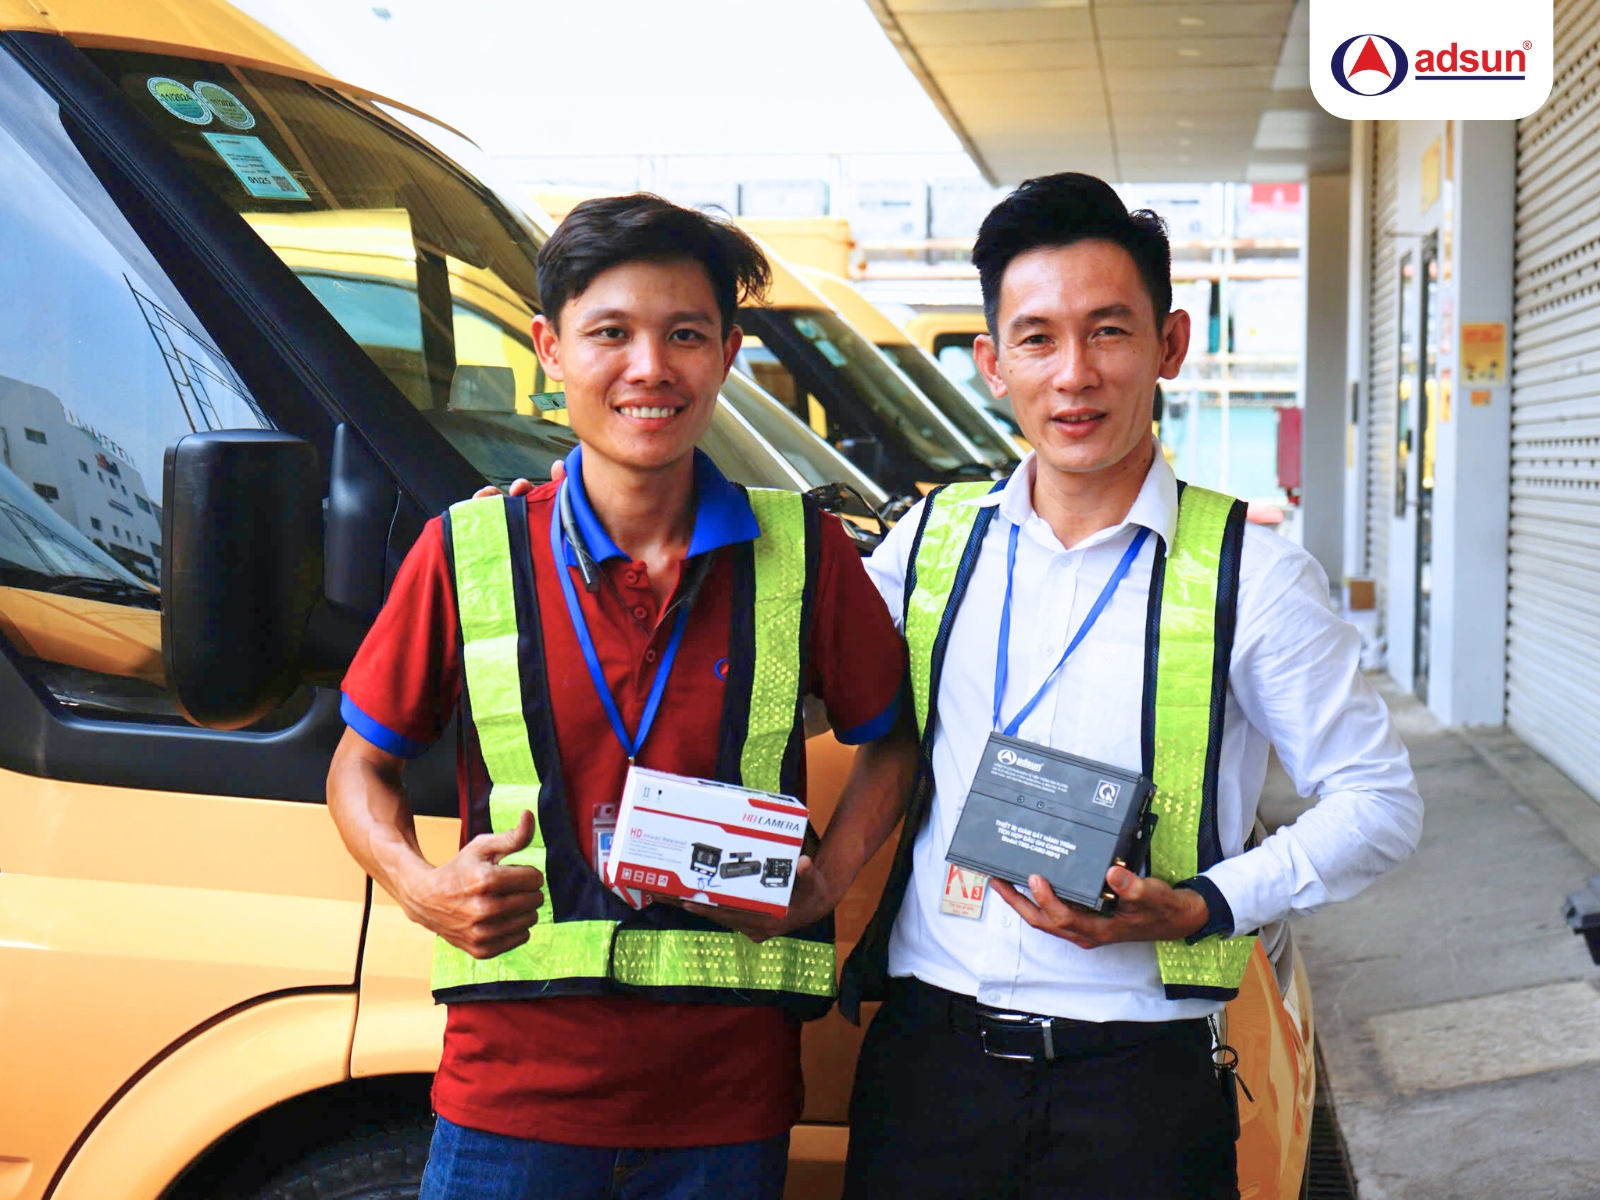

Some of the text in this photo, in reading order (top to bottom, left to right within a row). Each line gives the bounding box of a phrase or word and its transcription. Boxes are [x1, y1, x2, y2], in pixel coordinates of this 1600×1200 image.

[248, 176, 272, 185] 01/25
[758, 816, 800, 831] CAMERA
[630, 828, 642, 838] HD
